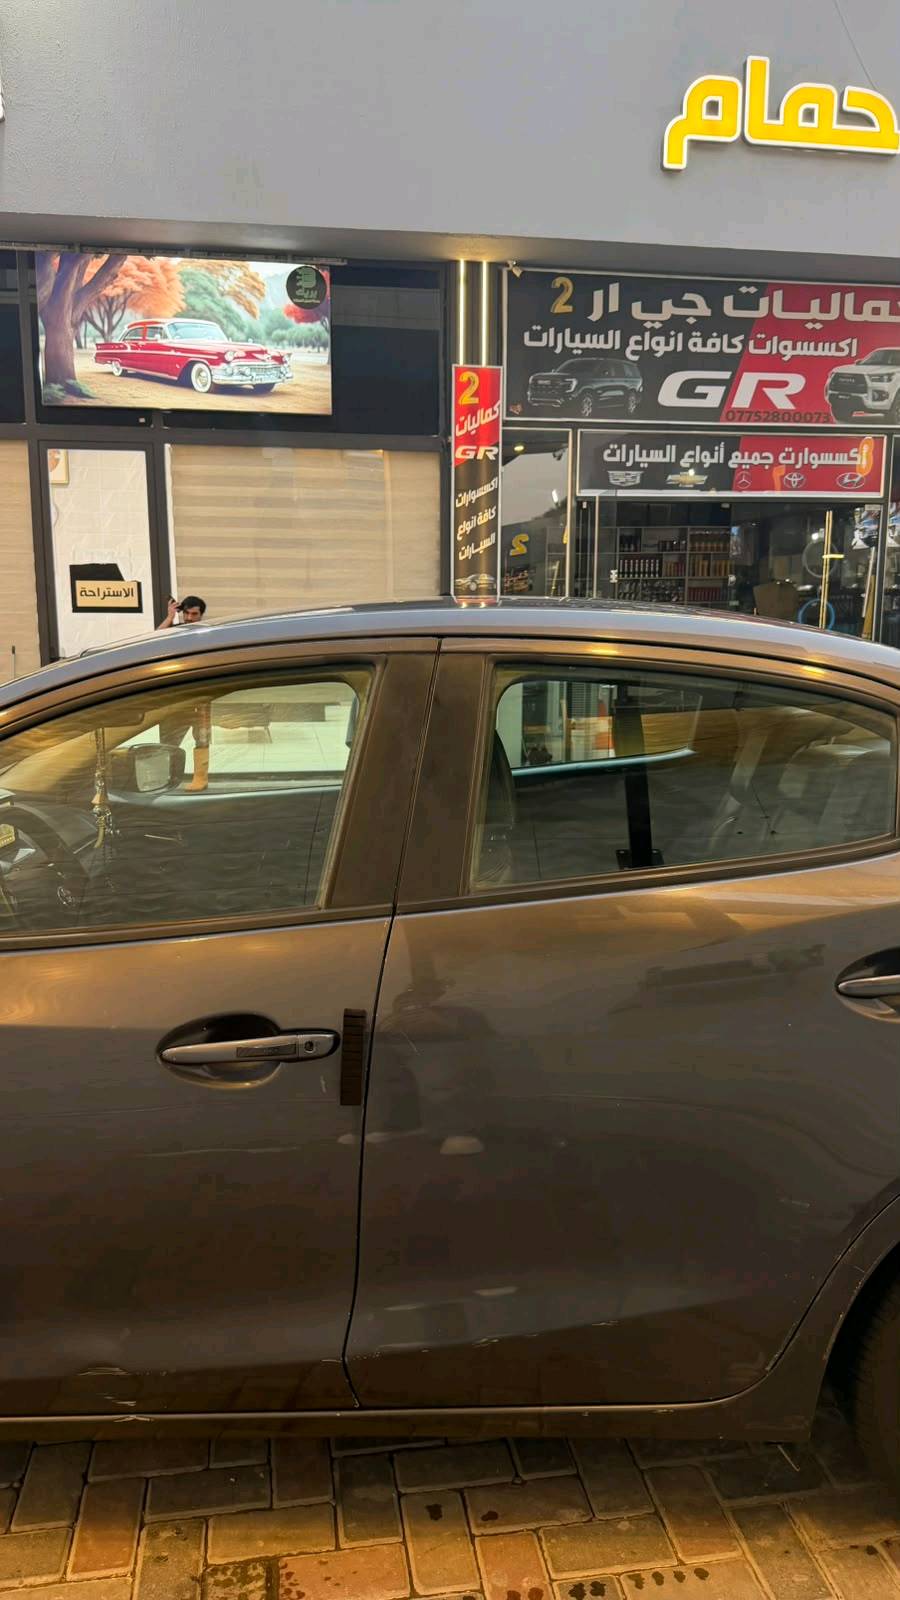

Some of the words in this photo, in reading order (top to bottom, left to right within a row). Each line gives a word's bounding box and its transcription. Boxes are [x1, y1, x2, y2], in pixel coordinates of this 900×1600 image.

[663, 55, 900, 170] حمام
[550, 276, 574, 314] 2
[587, 282, 620, 322] ار
[723, 285, 900, 329] ماليات
[632, 292, 712, 329] جي
[523, 325, 621, 354] السيارات
[625, 330, 683, 361] انواع
[687, 331, 745, 354] كافة
[748, 333, 858, 361] اكسسوات
[458, 370, 480, 405] 2
[657, 370, 806, 410] GR
[455, 400, 501, 437] كماليات
[455, 445, 499, 460] GR
[603, 444, 677, 467] السيارات
[680, 442, 725, 468] أنواع
[728, 450, 774, 469] جميع
[455, 476, 498, 508] اكسسوارات
[456, 515, 477, 541] انواع
[477, 506, 497, 526] كافة
[458, 532, 496, 561] السيارات
[79, 586, 135, 601] الاستراحة
